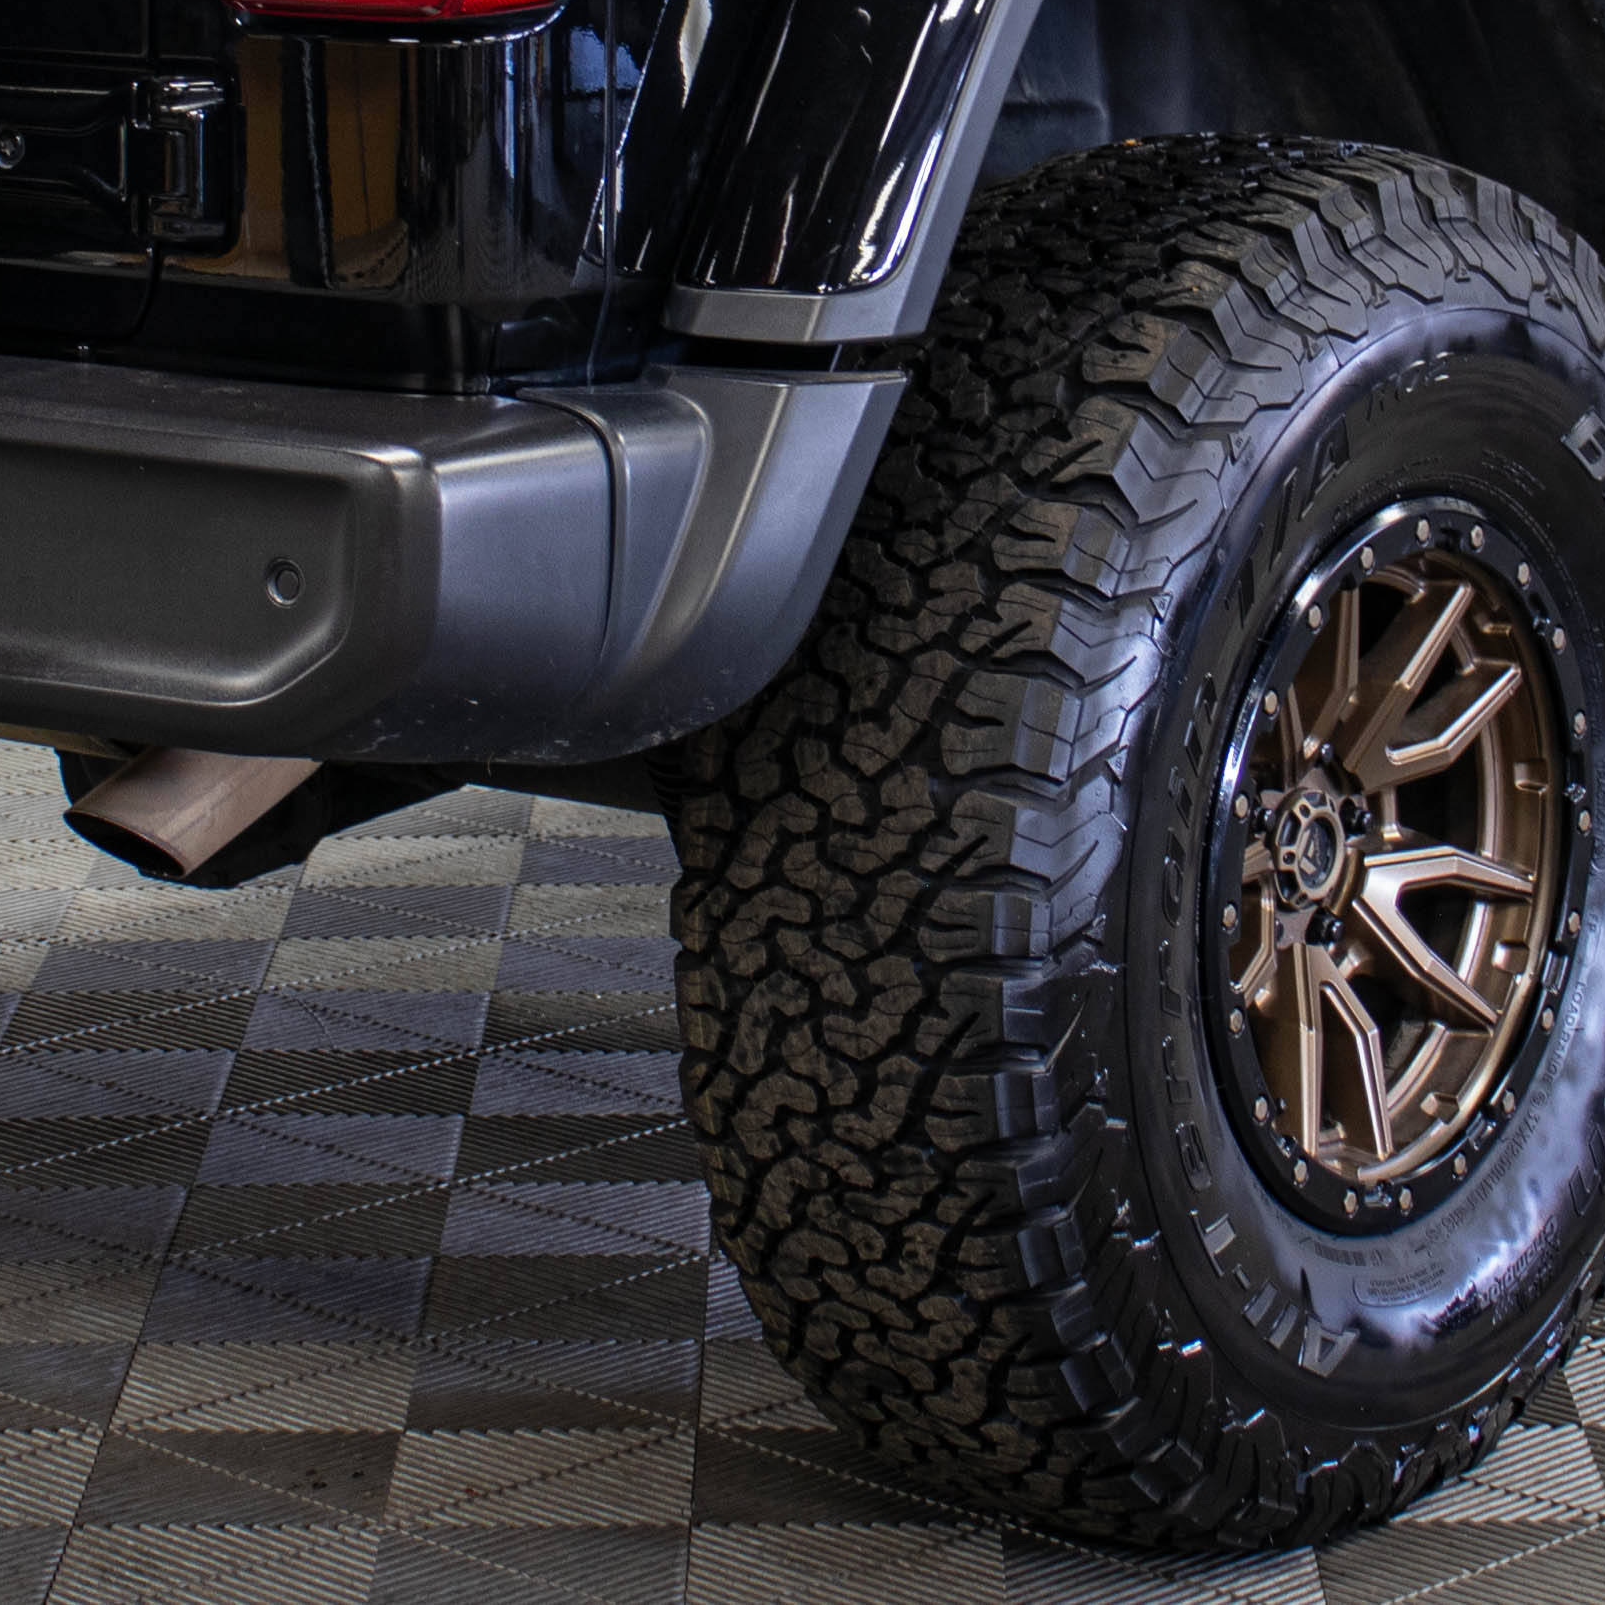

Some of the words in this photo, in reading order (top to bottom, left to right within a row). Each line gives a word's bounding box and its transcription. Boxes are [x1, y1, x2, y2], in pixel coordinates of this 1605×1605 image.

[1222, 407, 1352, 629] T/A
[1158, 671, 1359, 1378] All-Terrain
[1565, 981, 1587, 1030] LOAD
